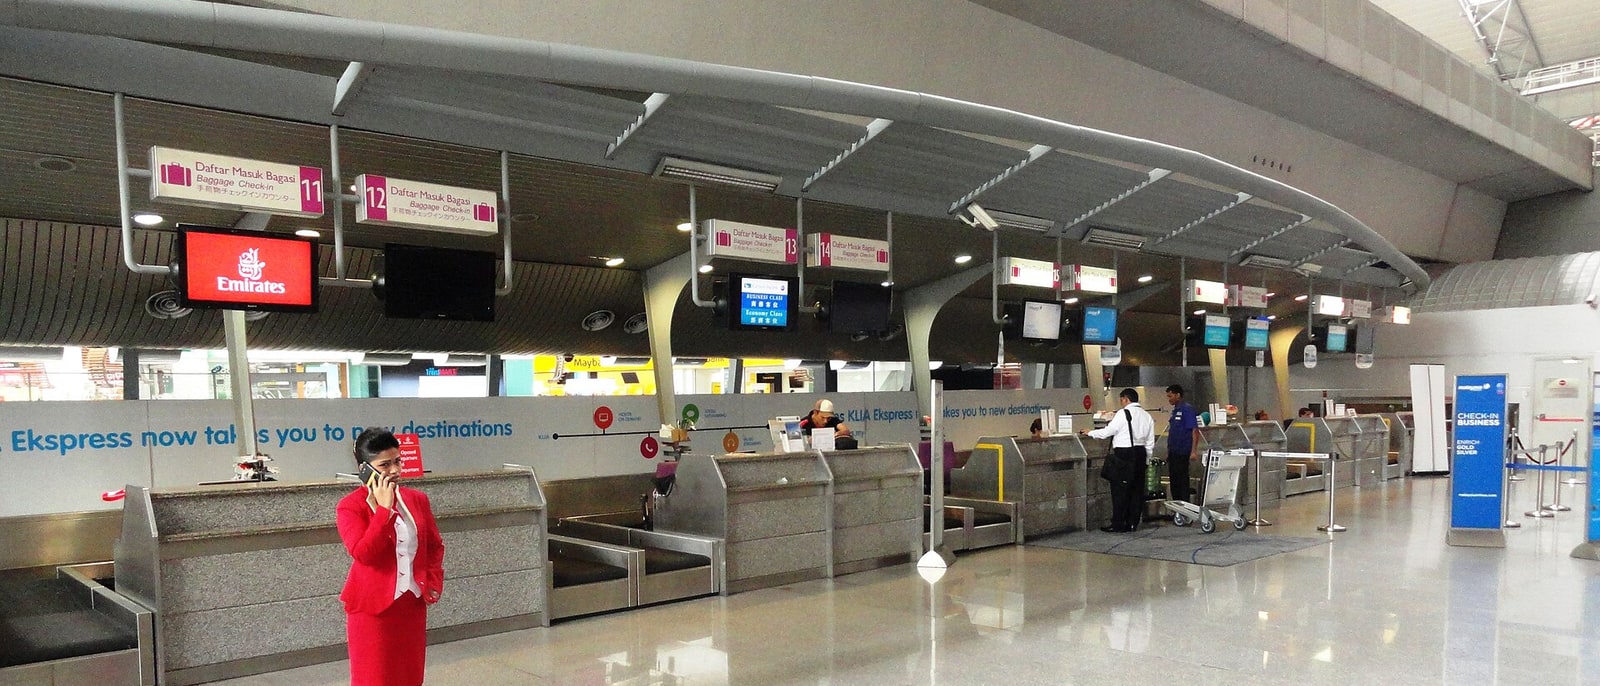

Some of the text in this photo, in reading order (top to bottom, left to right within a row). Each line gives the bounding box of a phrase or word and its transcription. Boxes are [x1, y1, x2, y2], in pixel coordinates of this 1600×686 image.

[195, 161, 296, 184] Daftar Masuk Bagasi
[196, 174, 274, 191] Baggage Check-in
[301, 179, 321, 202] 11
[366, 186, 386, 209] 12
[390, 186, 471, 206] Daftar Masuk Bagasi
[409, 200, 471, 214] Baggage Check-in
[786, 238, 797, 255] 13
[820, 241, 830, 258] 14
[1053, 269, 1060, 282] 15
[216, 276, 286, 294] Emirates
[847, 408, 870, 421] KLIA
[873, 407, 913, 423] Ekspress
[942, 403, 1051, 420] kes you to new destinati
[402, 420, 513, 438] destinations
[11, 428, 133, 456] Ekspress
[141, 429, 197, 447] now
[204, 423, 270, 445] taks
[275, 428, 317, 448] you
[322, 423, 345, 442] to
